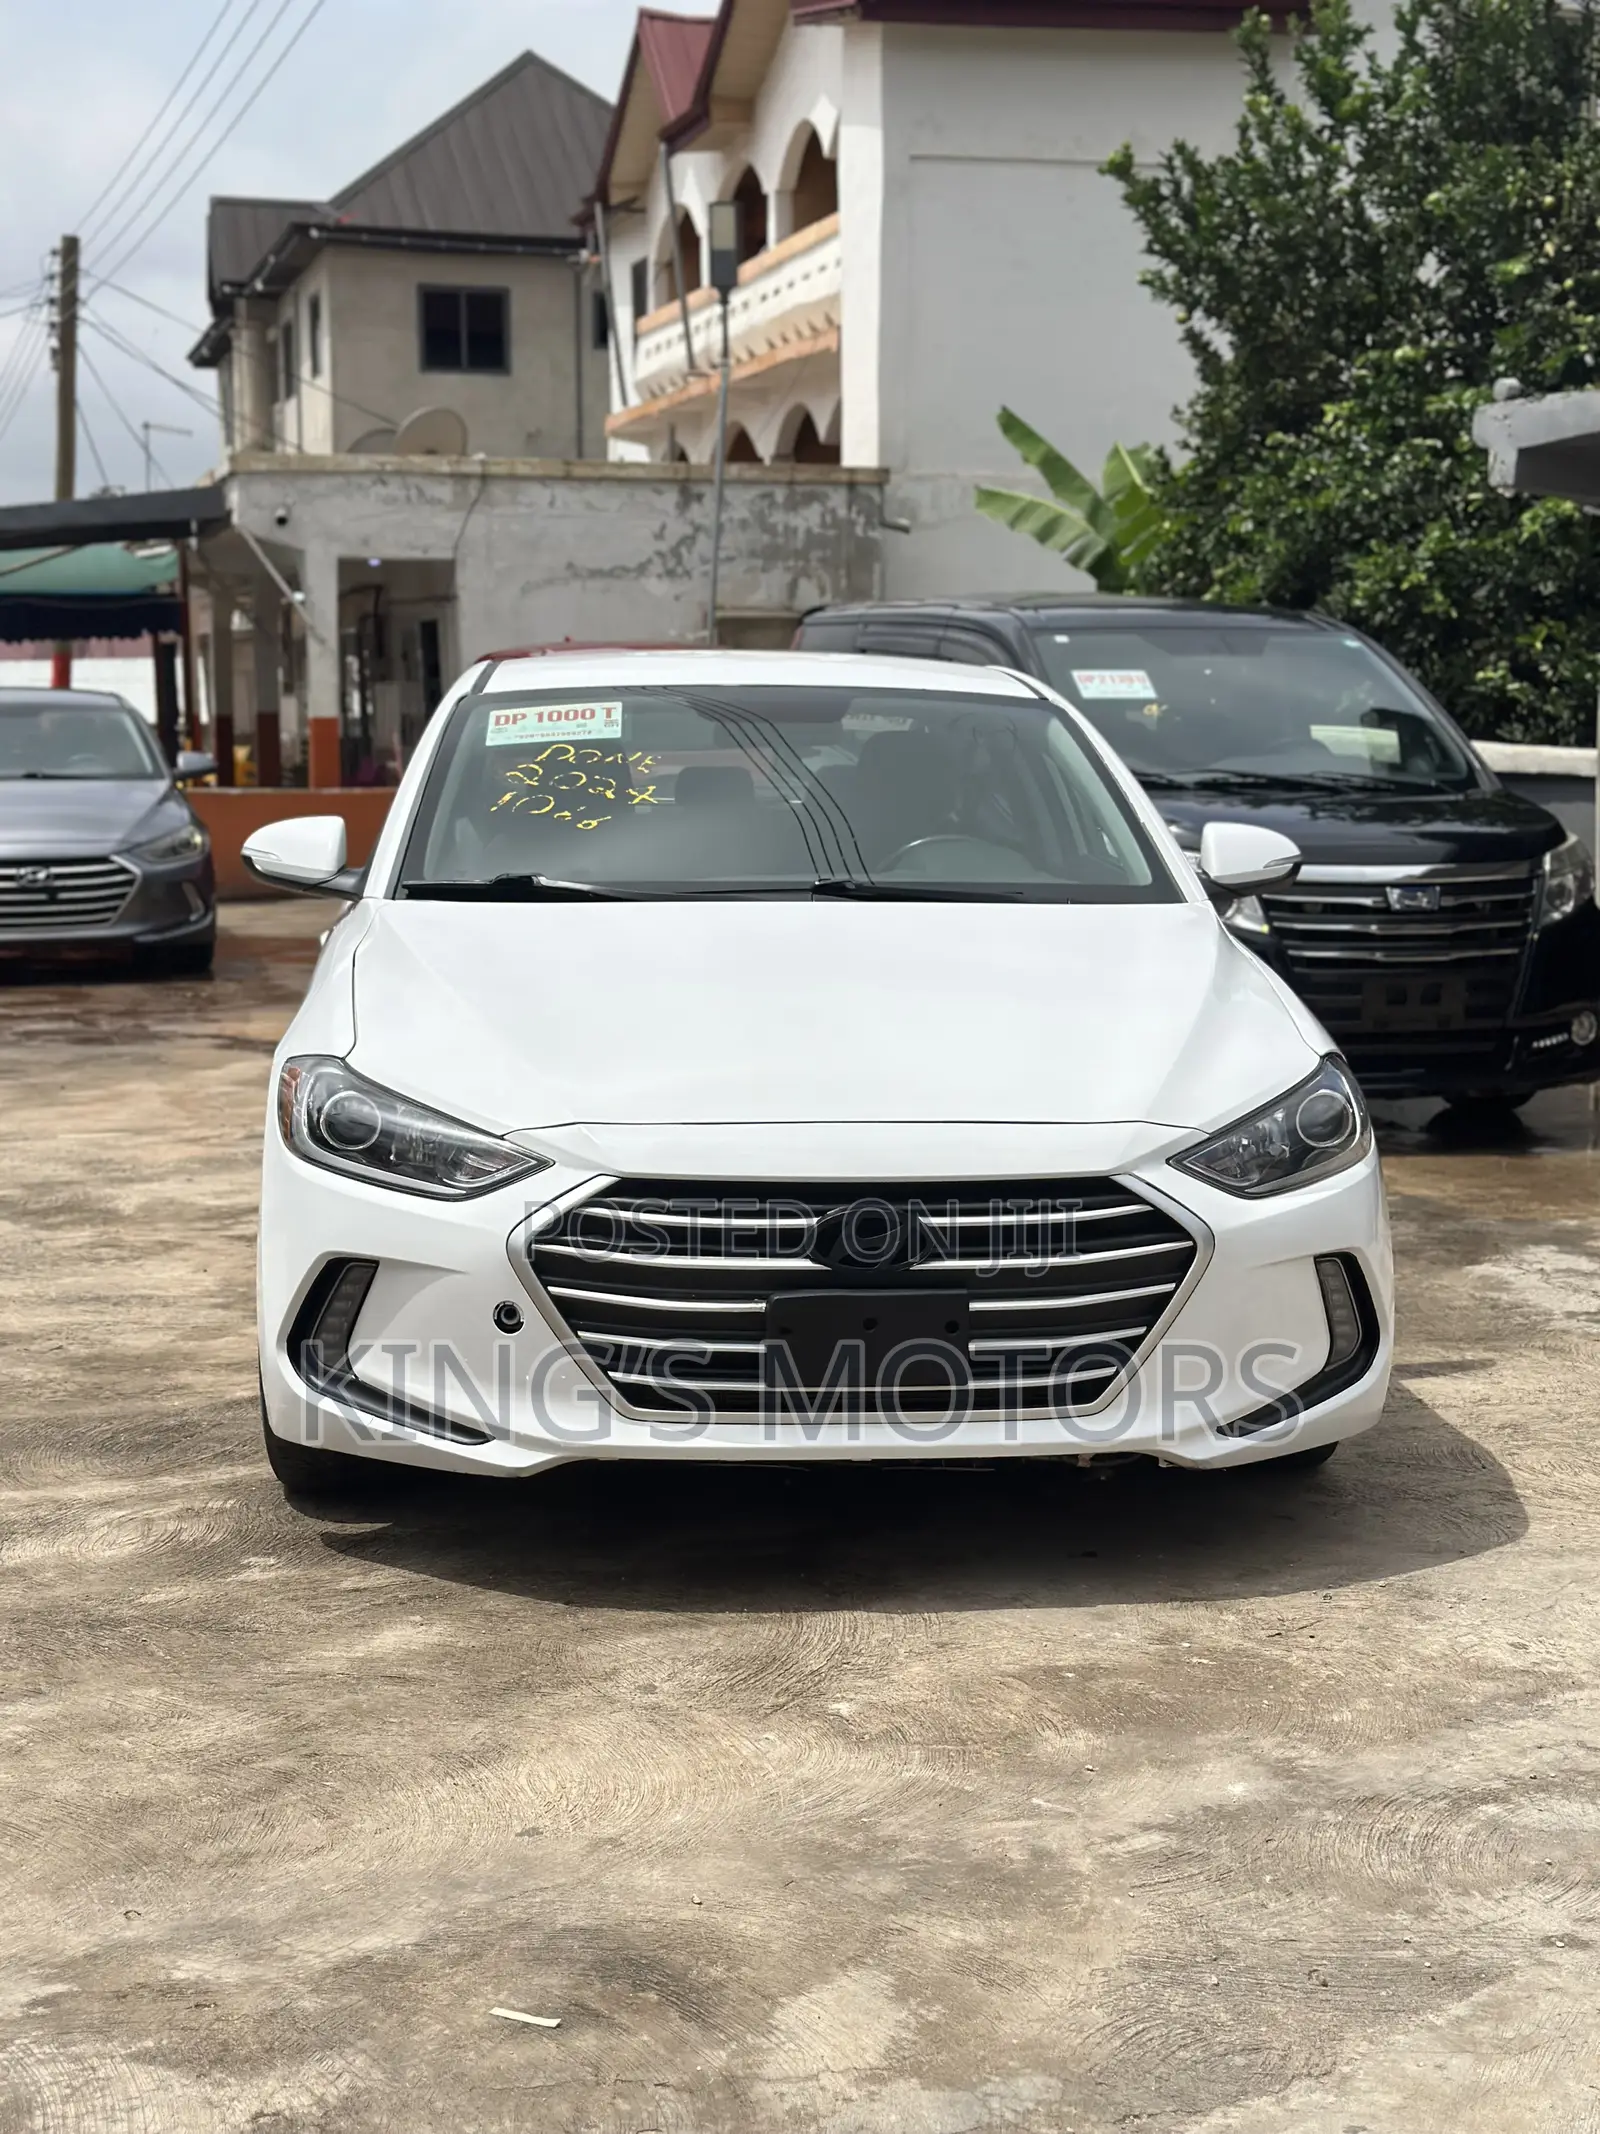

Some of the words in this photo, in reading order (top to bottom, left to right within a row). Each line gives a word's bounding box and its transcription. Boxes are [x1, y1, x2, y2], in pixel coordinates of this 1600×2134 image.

[494, 713, 528, 727] DP
[535, 708, 596, 724] 1000
[601, 706, 617, 720] T
